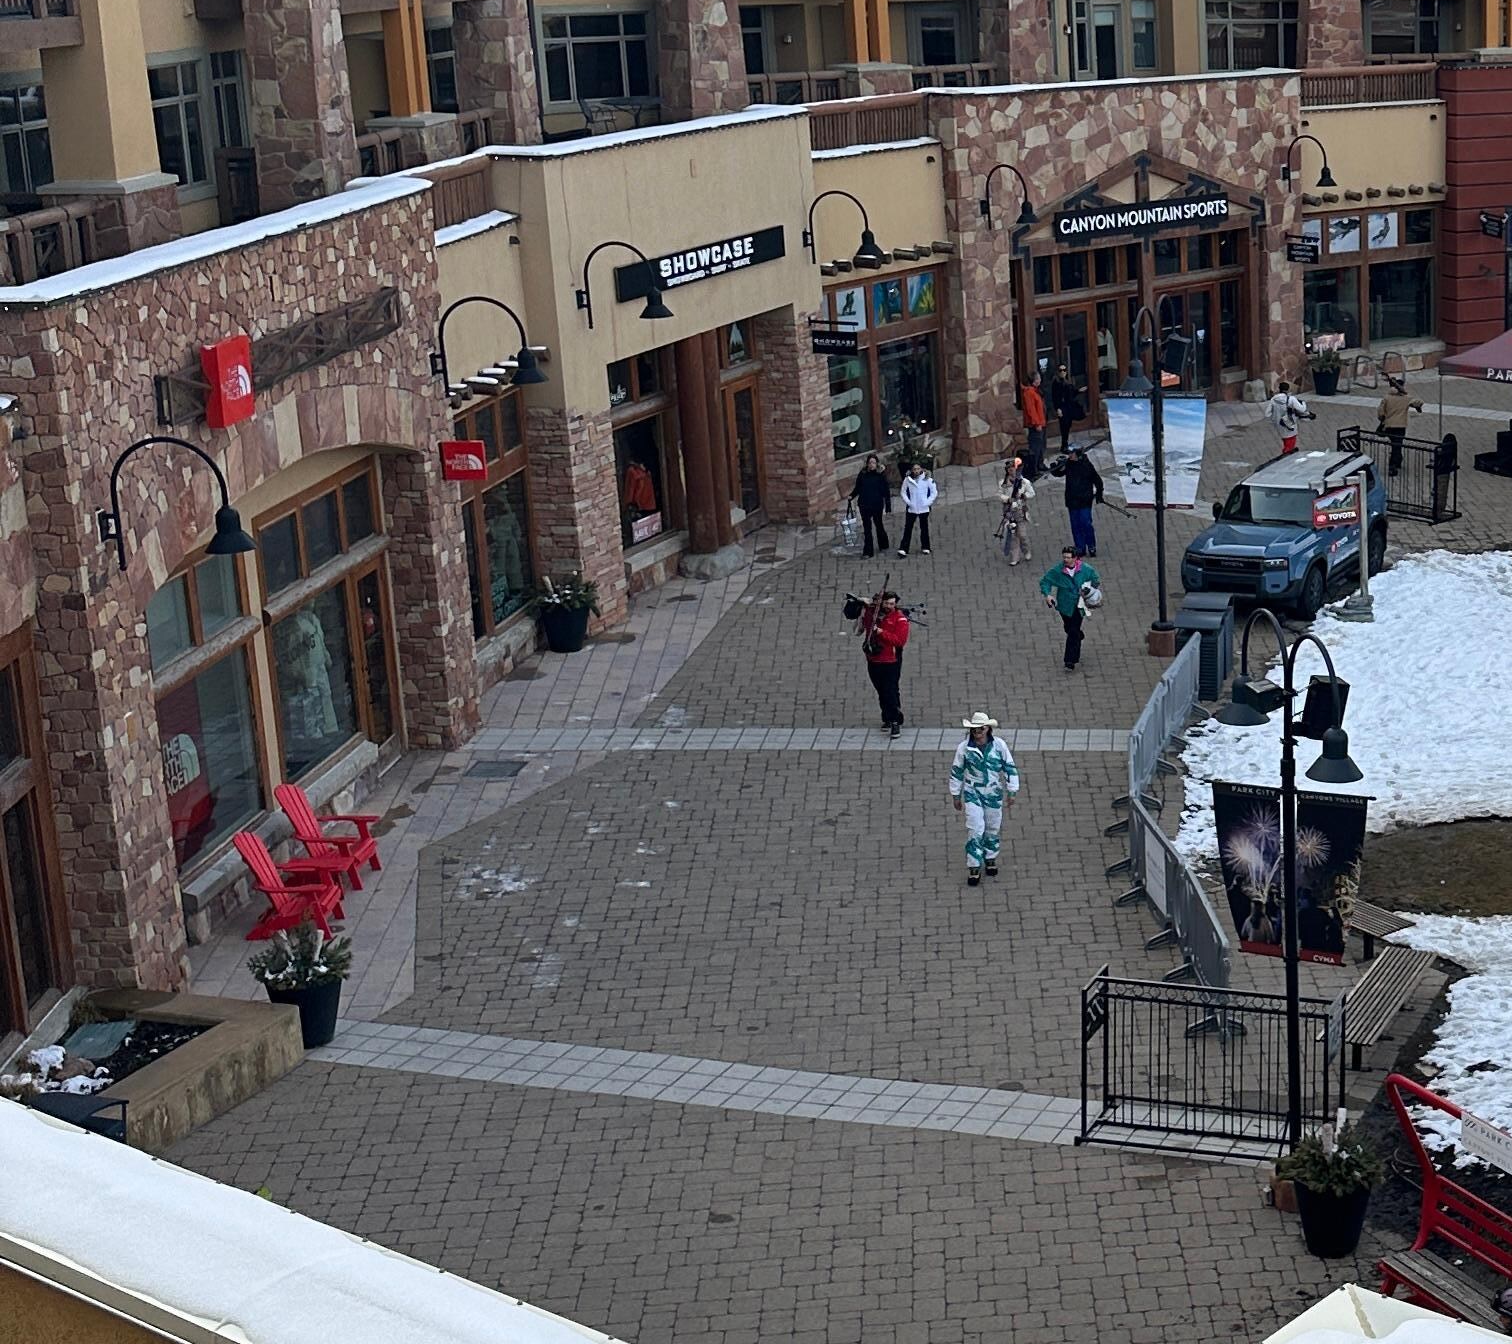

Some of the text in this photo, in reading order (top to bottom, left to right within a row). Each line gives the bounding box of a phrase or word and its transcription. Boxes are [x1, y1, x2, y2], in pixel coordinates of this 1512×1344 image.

[1060, 199, 1228, 234] CANYON MOUNTAIN SPORTS
[659, 236, 755, 278] SHOWCASE
[1328, 511, 1357, 521] TOYOTA
[1231, 785, 1276, 797] PARK CITY
[1313, 954, 1335, 963] CVMA
[1480, 1126, 1502, 1145] PARK
